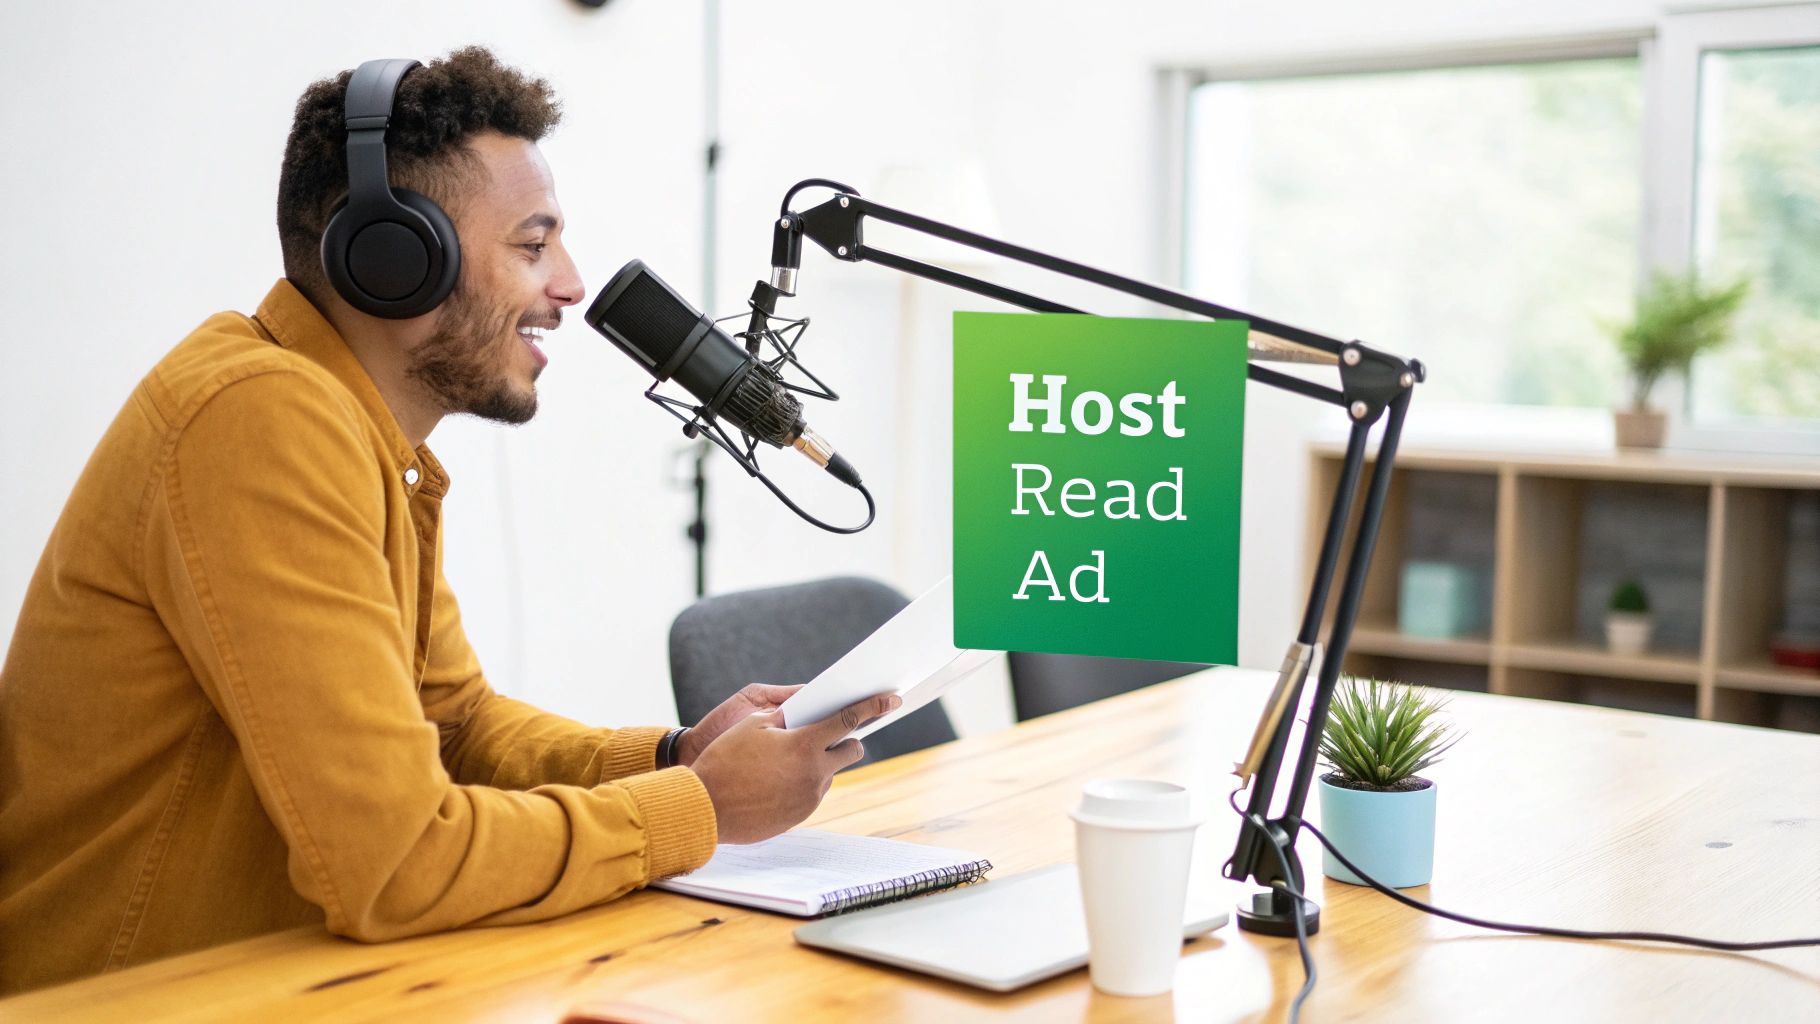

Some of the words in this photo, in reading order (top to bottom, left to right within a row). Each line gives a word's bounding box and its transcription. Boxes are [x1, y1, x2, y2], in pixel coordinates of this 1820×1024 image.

[1008, 373, 1186, 438] Host
[1010, 463, 1188, 522] Read
[1012, 550, 1110, 603] Ad
